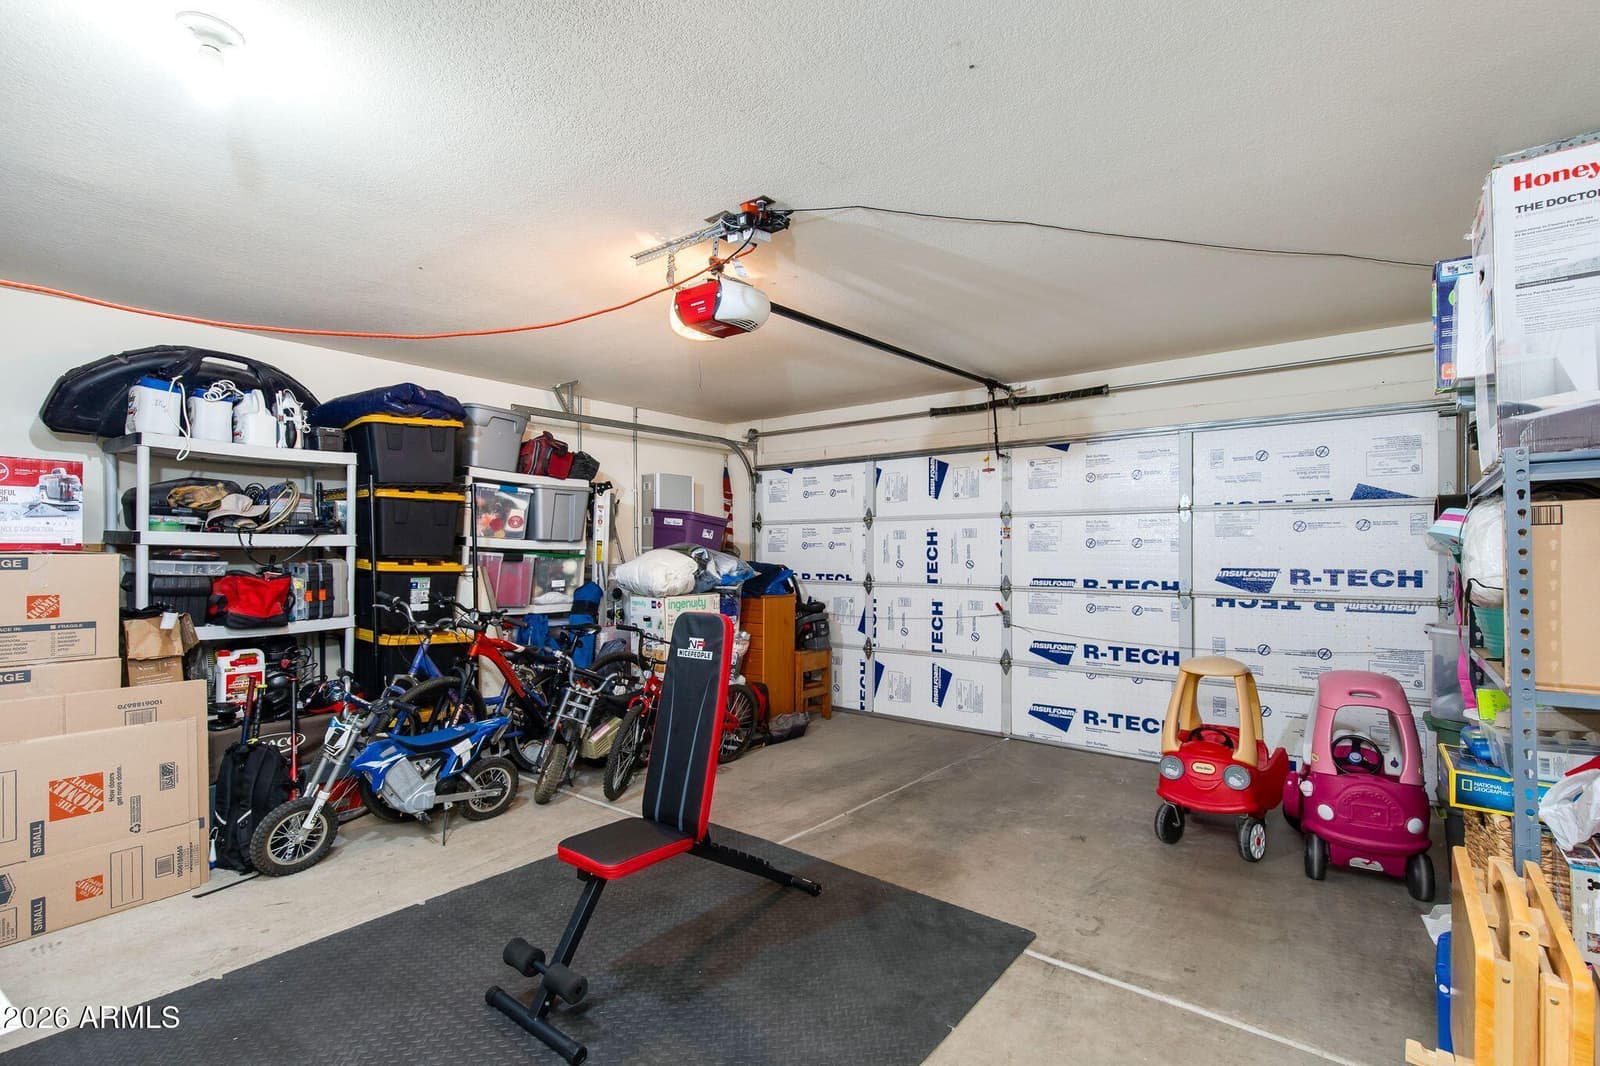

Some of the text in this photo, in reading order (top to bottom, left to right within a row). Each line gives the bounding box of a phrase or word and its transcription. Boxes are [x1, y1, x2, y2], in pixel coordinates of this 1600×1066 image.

[1515, 201, 1543, 213] THE
[1546, 189, 1600, 207] DOCTO
[1289, 569, 1424, 589] R-TECH
[27, 595, 61, 619] HOME
[668, 598, 707, 612] ingenuity
[679, 649, 711, 660] NICEPEOPLE
[1083, 644, 1180, 667] R-TECH
[1083, 710, 1166, 735] R-TEC
[49, 780, 104, 813] HOME
[1473, 782, 1503, 791] NATIONAL
[1473, 786, 1511, 797] GEOGRAPHIC
[33, 823, 43, 854] SMALL
[33, 900, 43, 931] SMALL
